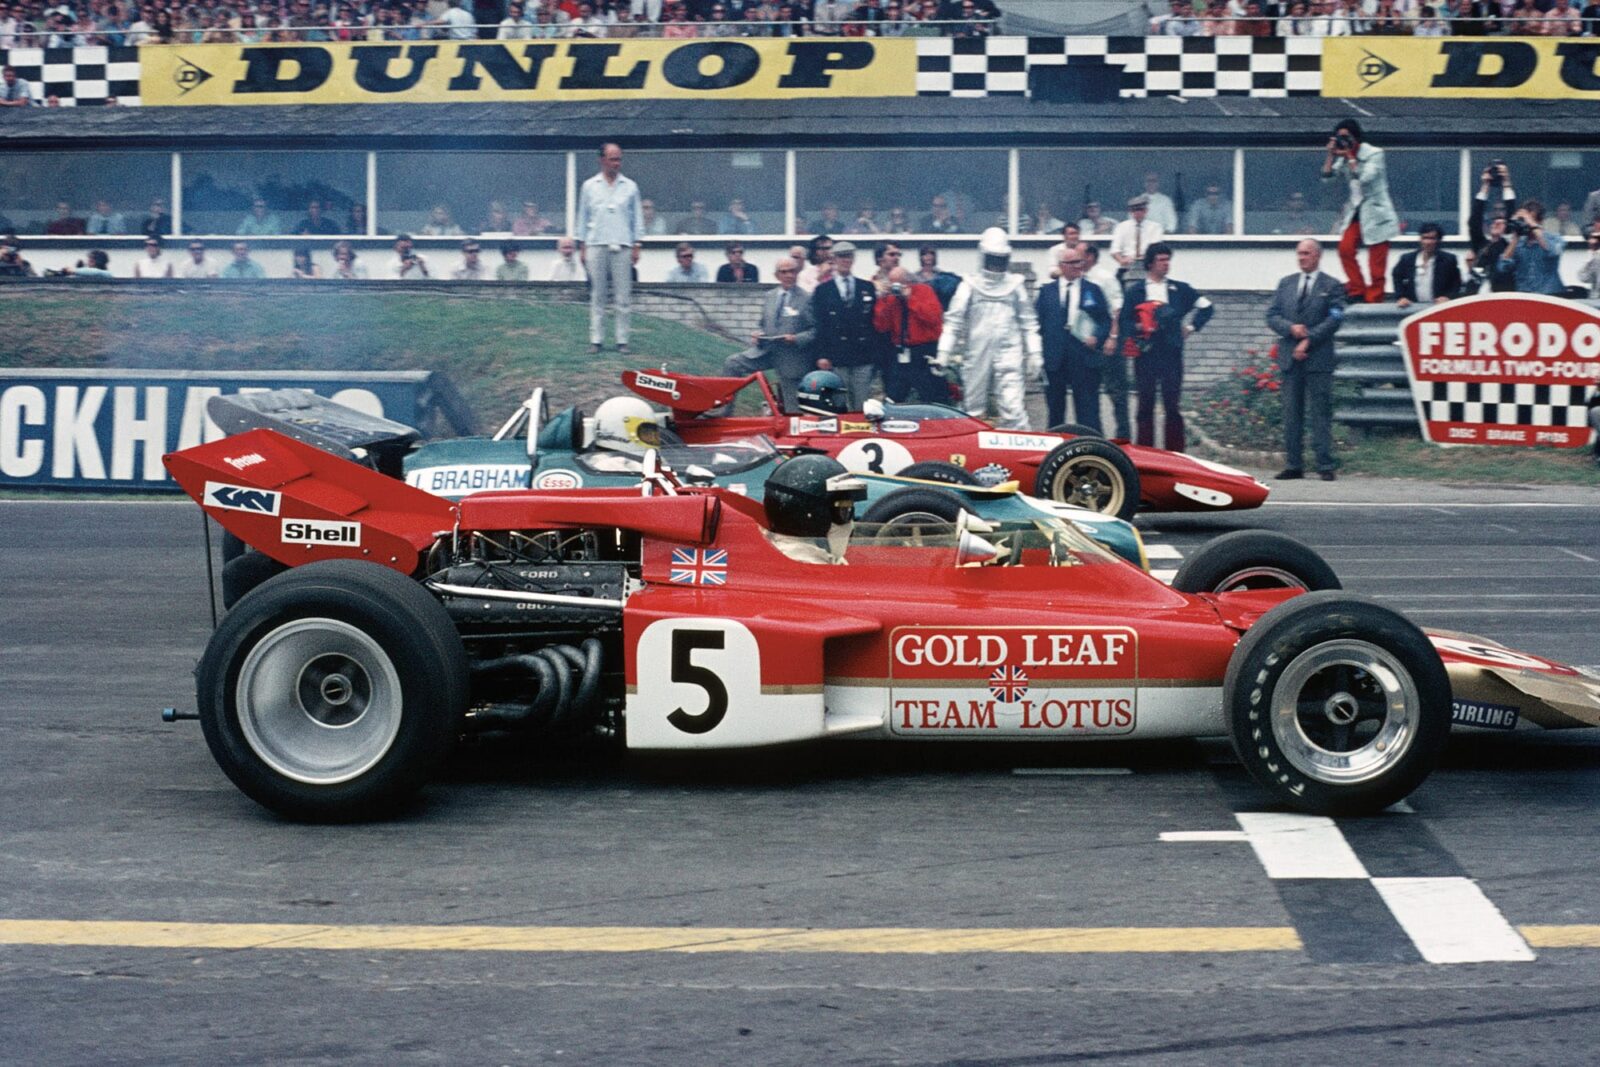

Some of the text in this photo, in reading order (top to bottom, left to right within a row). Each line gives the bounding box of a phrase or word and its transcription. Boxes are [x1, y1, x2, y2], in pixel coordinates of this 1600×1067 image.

[232, 40, 876, 94] DUNLOP
[1418, 321, 1600, 358] FERODO
[1419, 358, 1500, 376] FORMULA
[638, 375, 675, 390] Shell
[431, 469, 530, 491] BRABHAM
[284, 523, 357, 543] Shell
[895, 634, 1129, 666] GOLD LEAF
[666, 629, 729, 735] 5
[895, 699, 1133, 729] TEAM LOTUS
[1450, 702, 1515, 726] GIRLING
